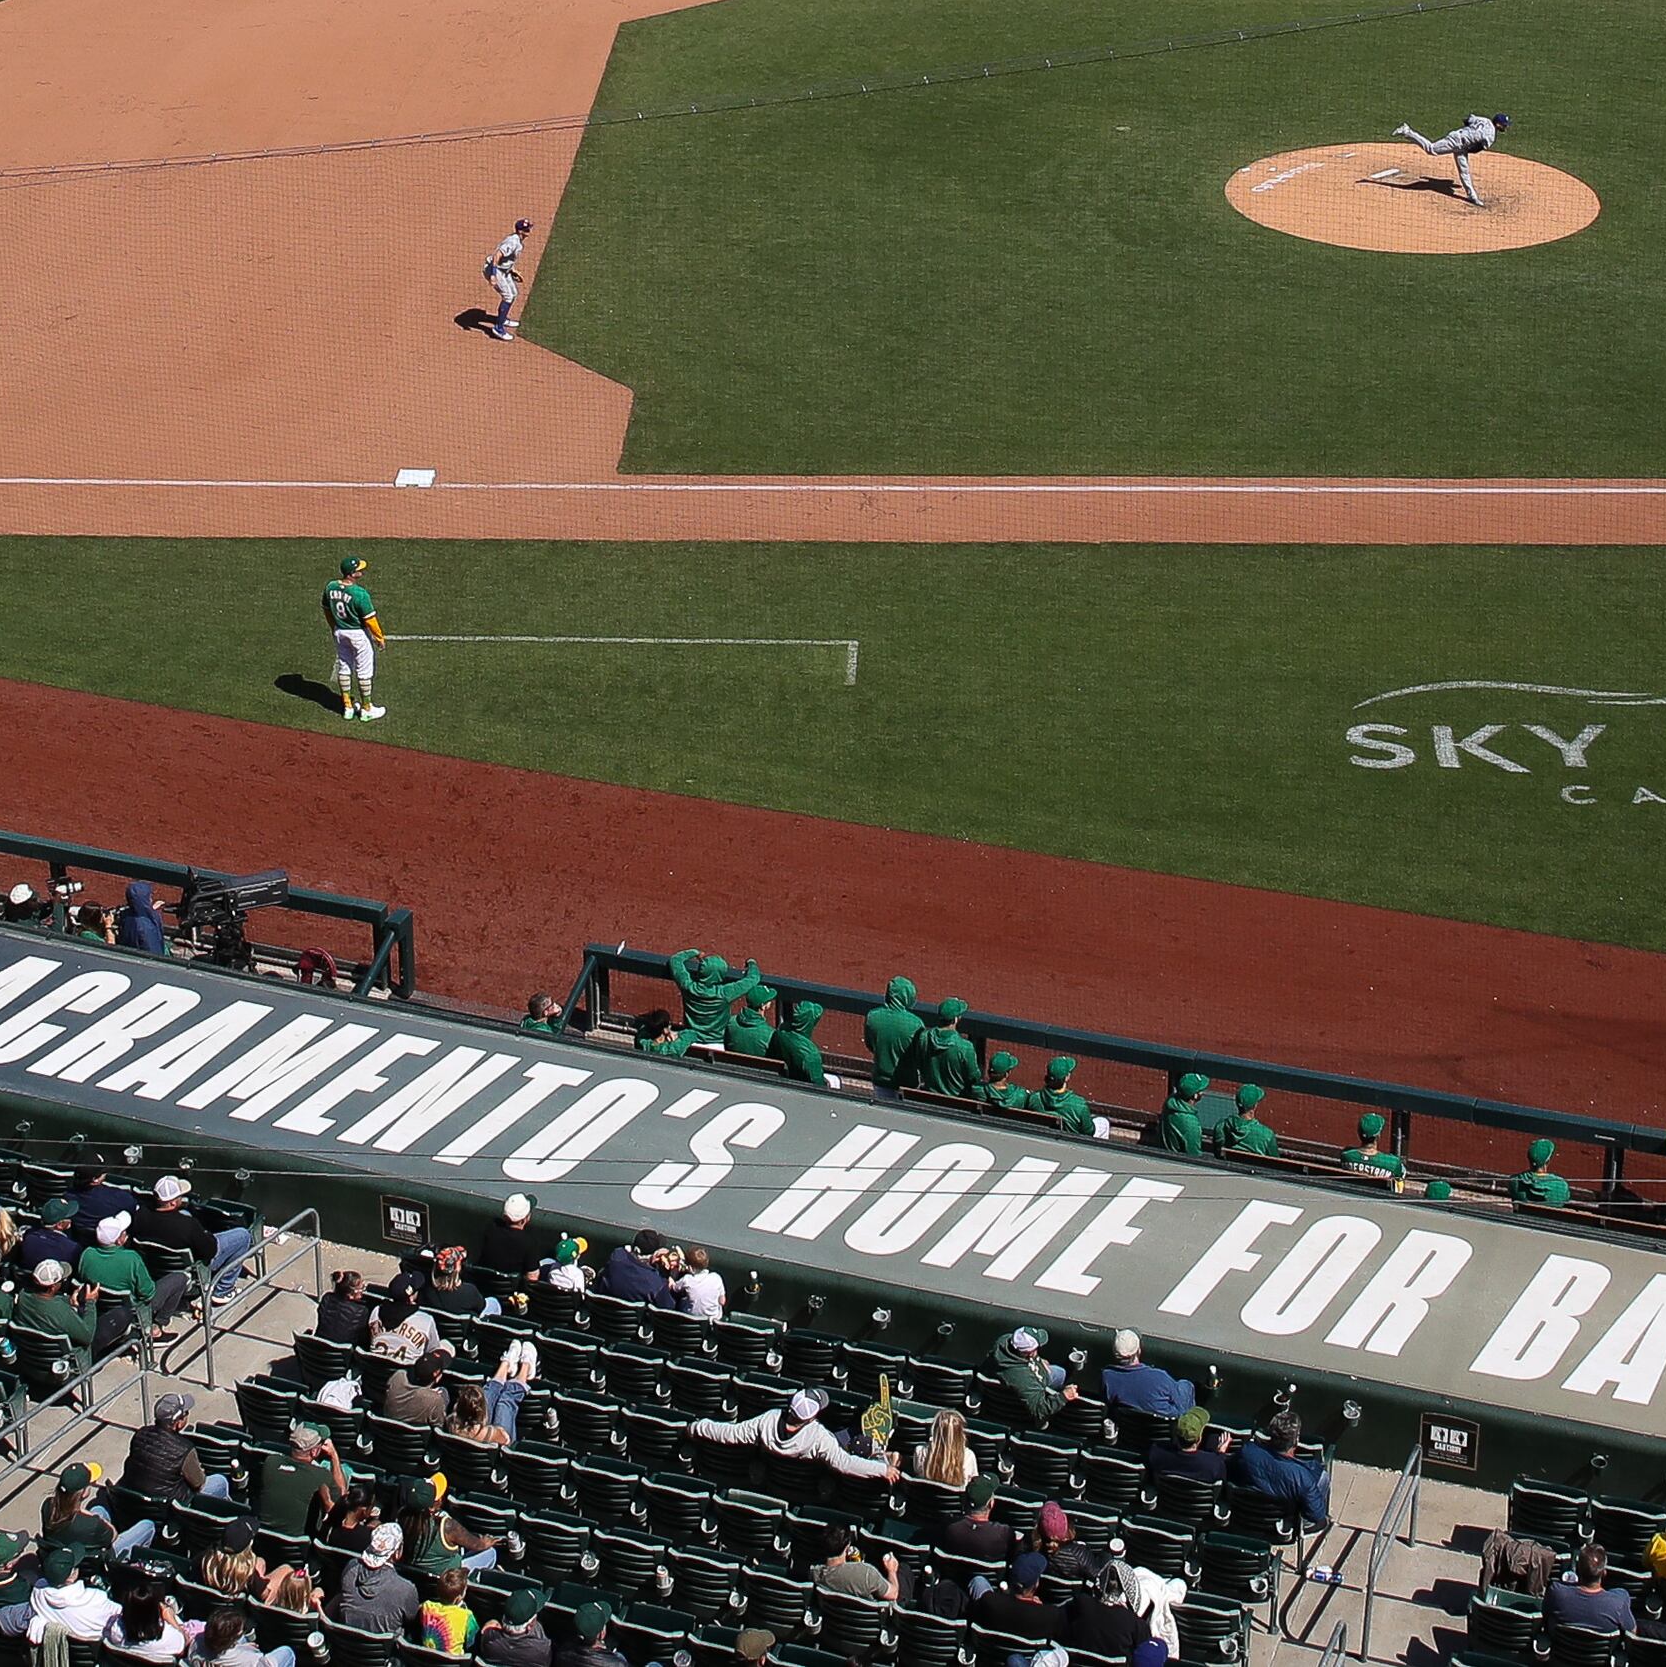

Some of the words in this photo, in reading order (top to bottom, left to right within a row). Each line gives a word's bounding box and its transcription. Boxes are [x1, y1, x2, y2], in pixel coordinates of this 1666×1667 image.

[1345, 722, 1608, 775] SKY
[748, 1126, 1184, 1296] HOME
[1158, 1205, 1474, 1355] FOR
